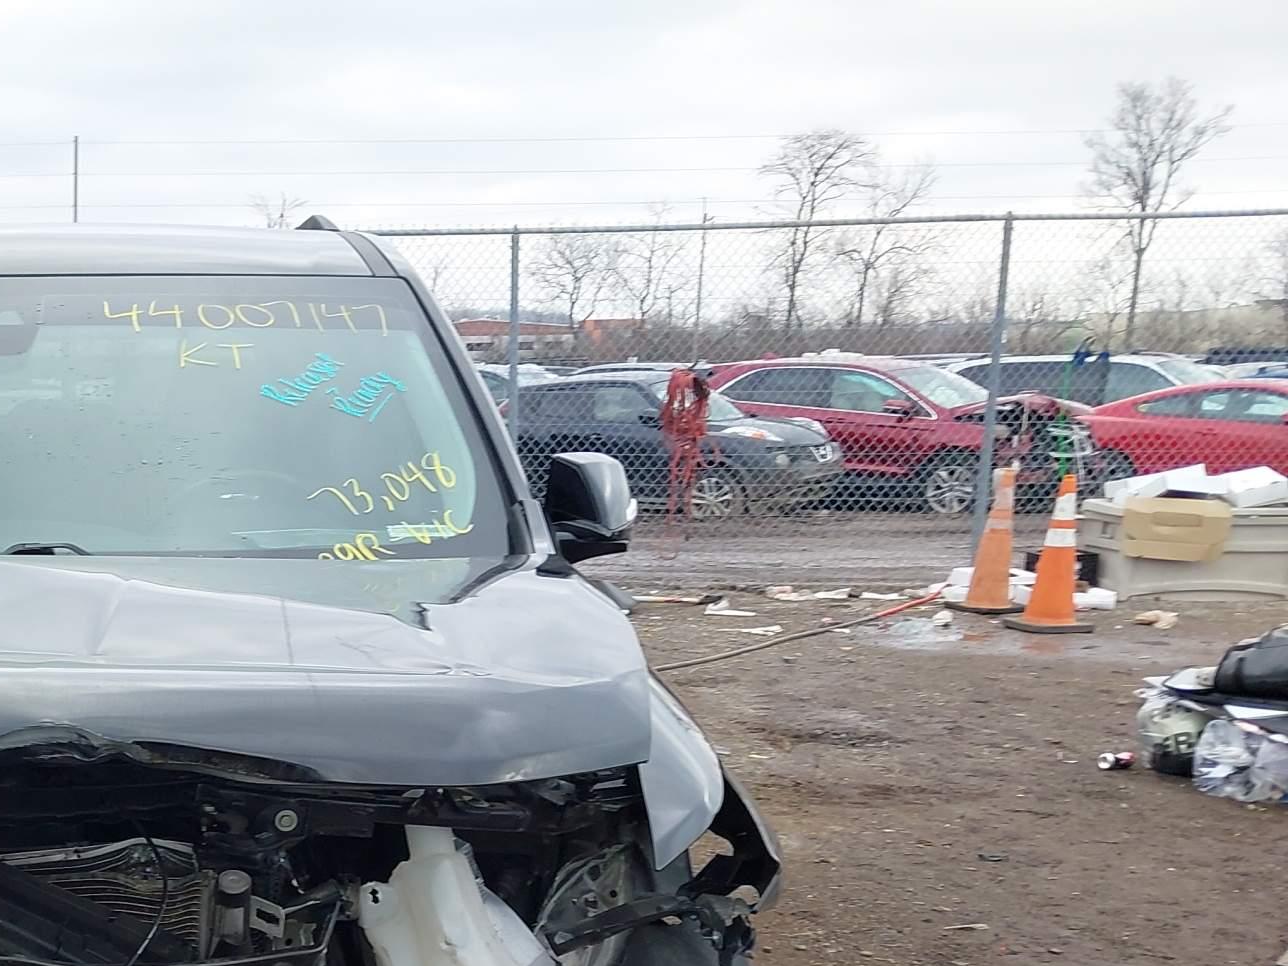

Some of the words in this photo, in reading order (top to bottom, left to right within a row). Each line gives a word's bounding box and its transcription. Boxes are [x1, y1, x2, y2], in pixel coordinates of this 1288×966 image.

[103, 300, 389, 337] 44007147
[178, 339, 255, 369] KT
[306, 451, 457, 516] 73,048
